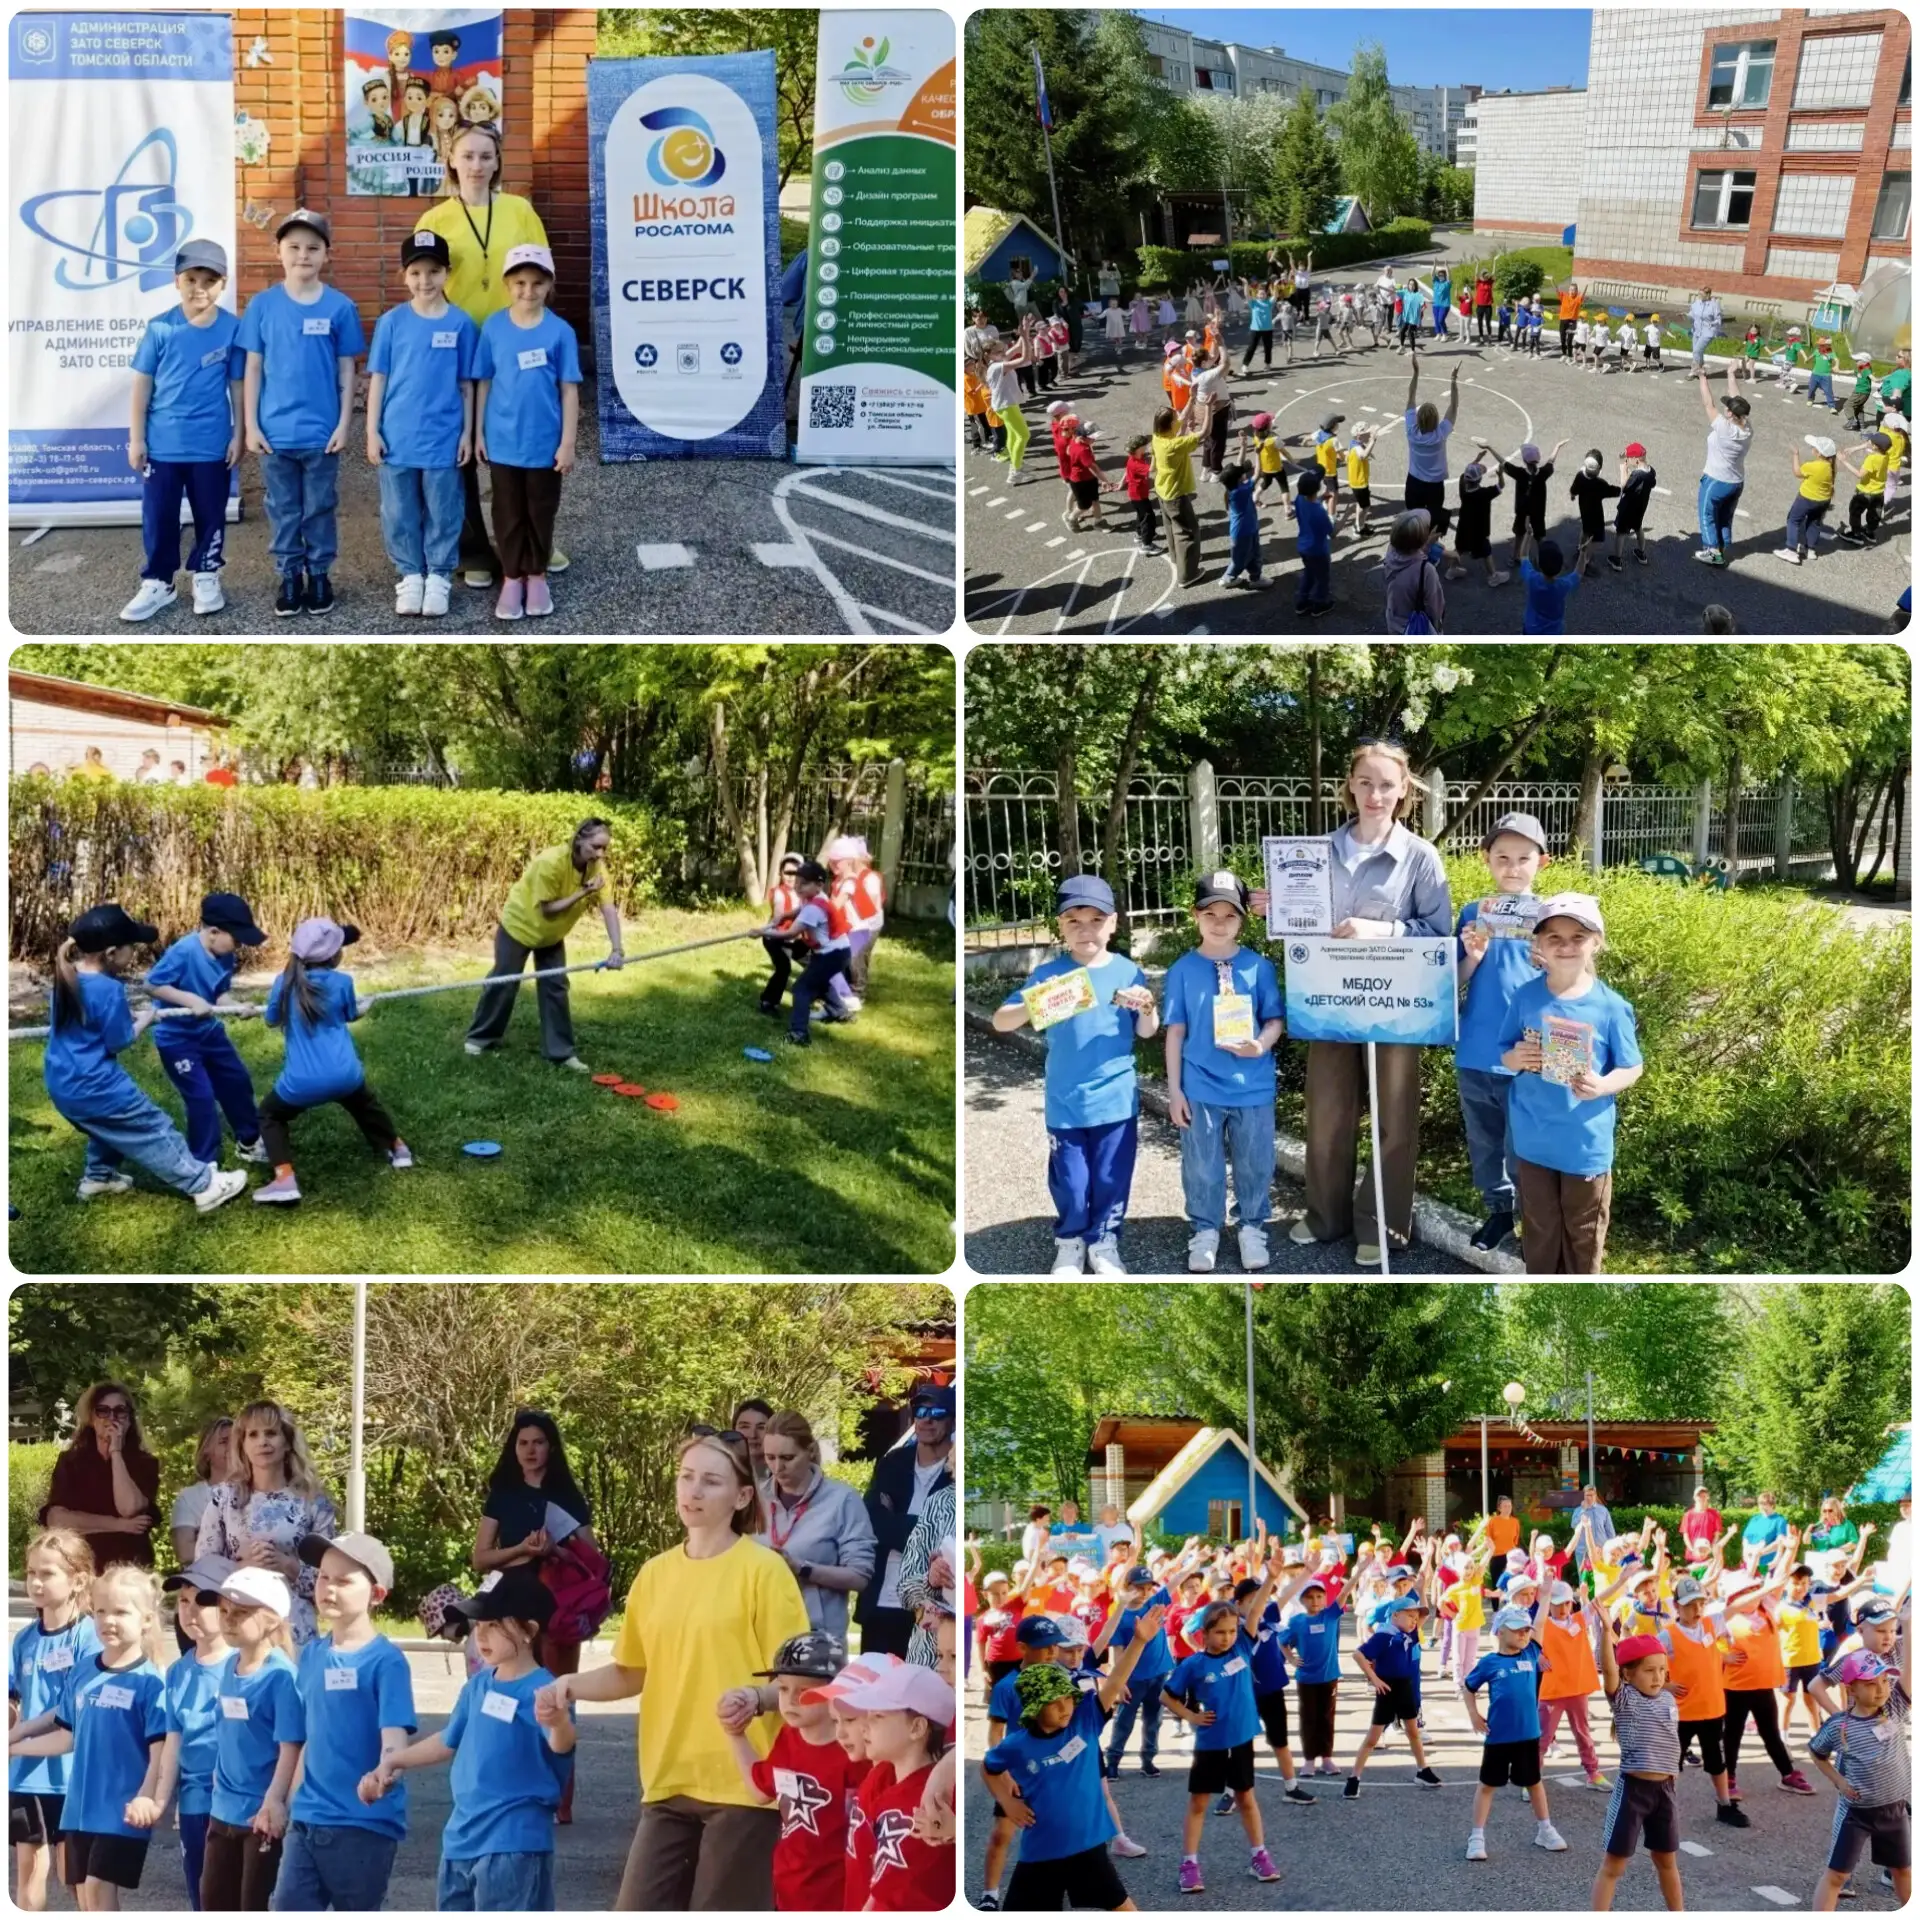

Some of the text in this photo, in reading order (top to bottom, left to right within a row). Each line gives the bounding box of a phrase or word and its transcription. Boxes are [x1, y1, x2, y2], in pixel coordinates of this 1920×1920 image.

[70, 22, 187, 35] АДМИНИСТРАЦИЯ
[70, 38, 162, 49] ЗАТО СЕВЕРСК
[69, 52, 193, 66] ТОМСКОЙ ОБЛАСТИ
[357, 152, 411, 164] РОССИЯ
[858, 166, 927, 176] Анализ данных
[855, 190, 938, 202] Дизайн программ
[633, 192, 736, 223] Школа
[854, 217, 908, 228] Поддержка
[635, 223, 735, 238] РОСАТОМА
[852, 241, 935, 253] Образовательные
[851, 266, 898, 277] Цифровая
[622, 277, 746, 302] СЕВЕРСК
[849, 291, 938, 302] Позиционирование
[848, 310, 939, 321] Профессиональный
[8, 319, 104, 333] УПРАВЛЕНИЕ
[856, 321, 909, 329] личностный
[911, 322, 934, 331] рост
[45, 336, 140, 352] АДМИНИСТР
[847, 335, 911, 345] Непрерывное
[846, 345, 934, 355] профессиональное
[59, 355, 94, 369] ЗАТО
[861, 386, 903, 396] Свяжись
[42, 443, 76, 452] Томская
[1320, 946, 1414, 958] Администрация ЗАТО Северск
[1329, 954, 1405, 962] Управление образования
[1342, 977, 1392, 993] МБДОУ
[1304, 993, 1434, 1009] «ДЕТСКИЙ САД № 53»
